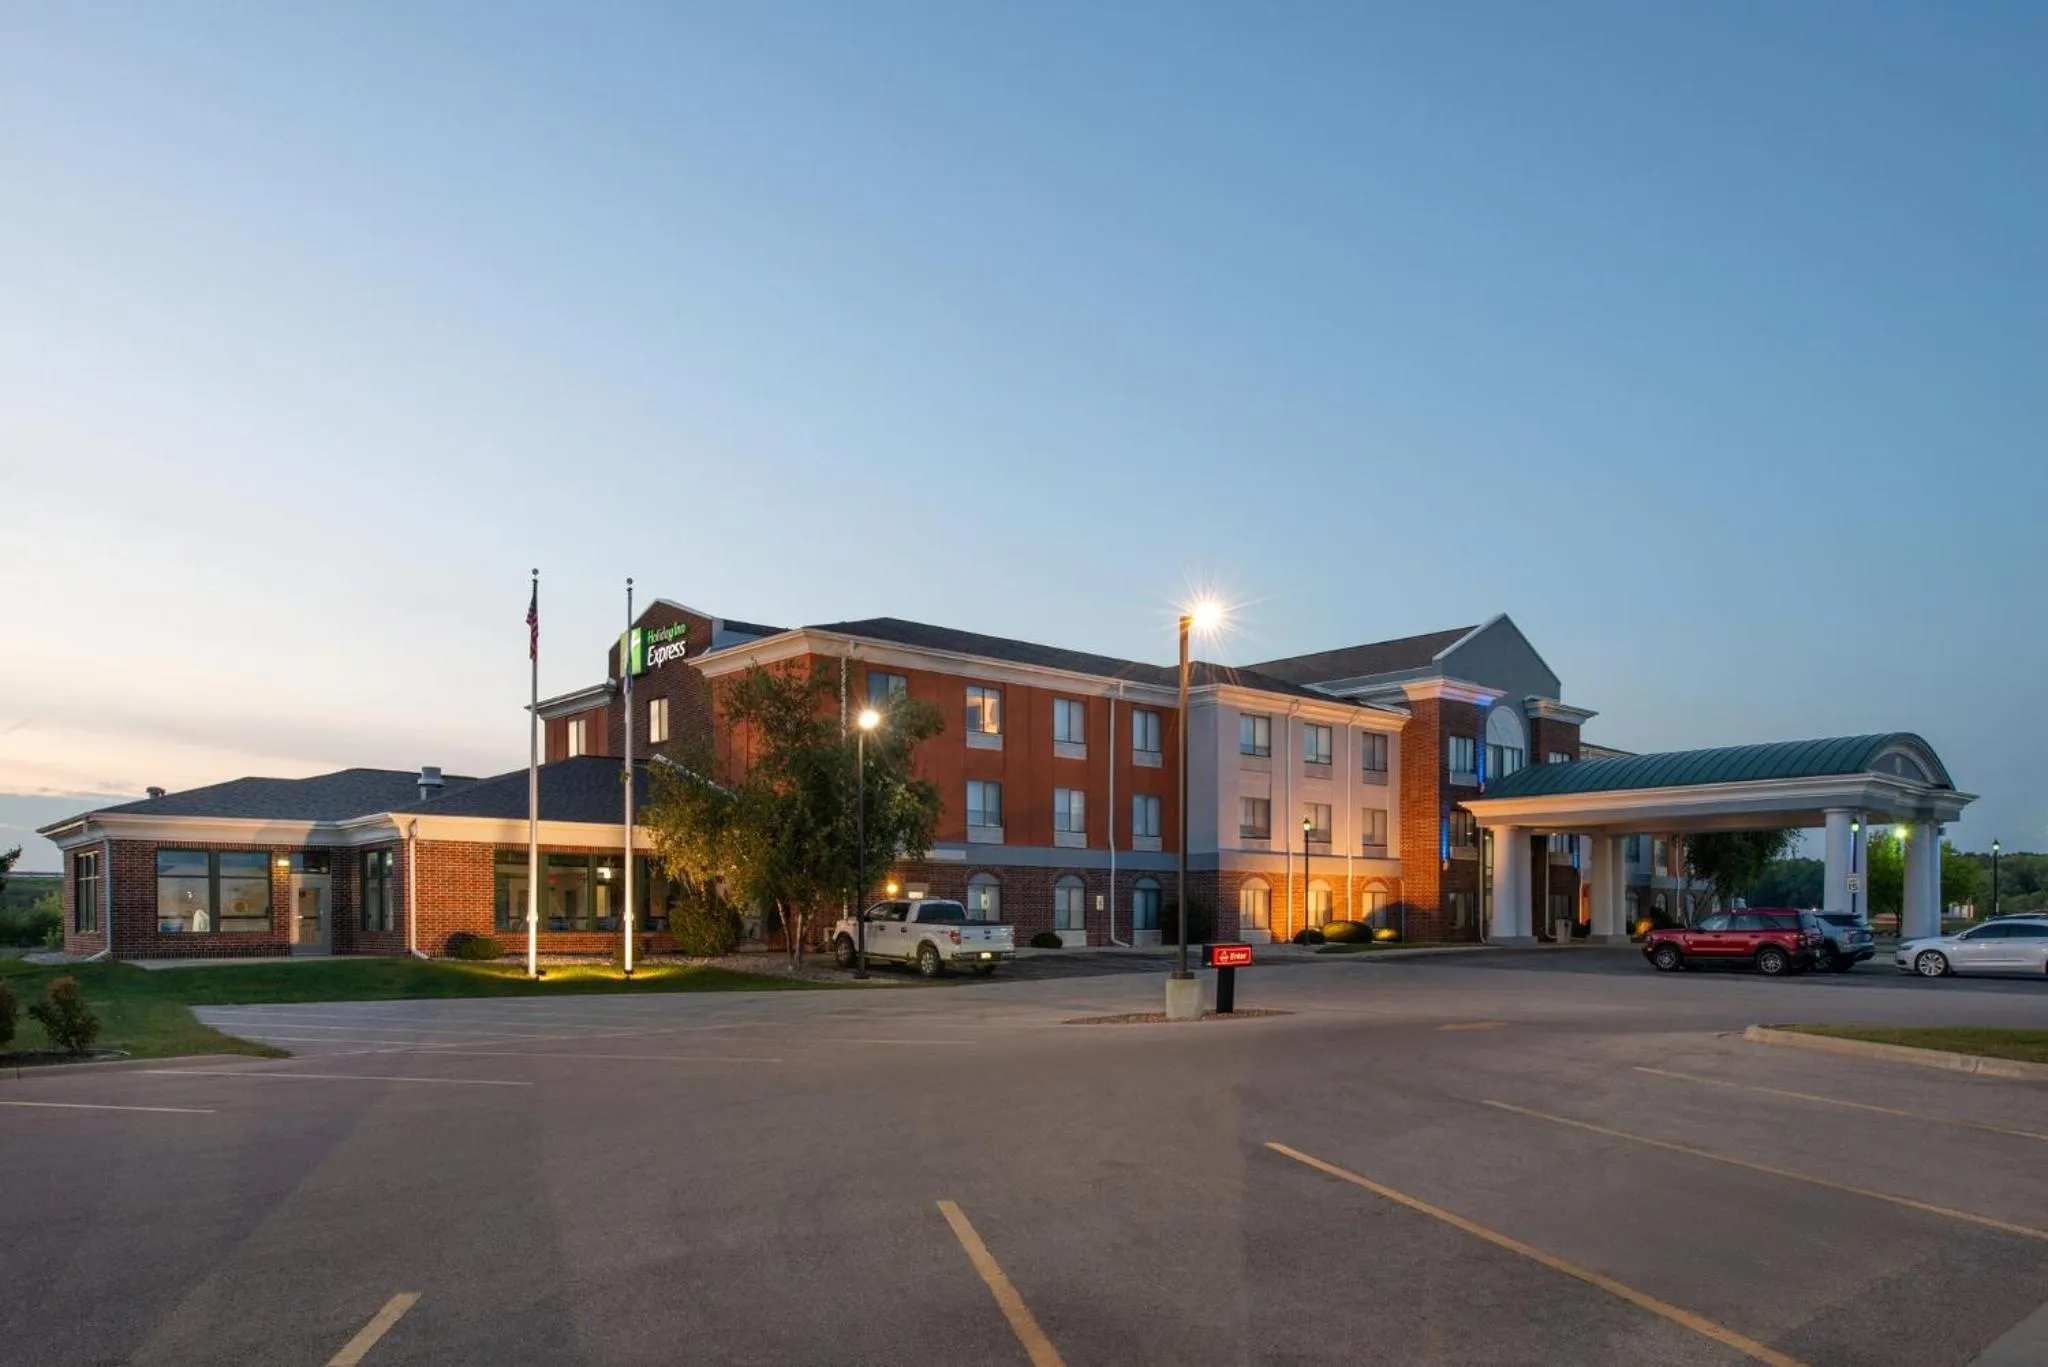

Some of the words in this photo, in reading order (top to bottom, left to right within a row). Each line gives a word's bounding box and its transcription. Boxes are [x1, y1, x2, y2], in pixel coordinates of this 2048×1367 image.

[647, 641, 686, 668] Express
[1848, 883, 1857, 891] 15
[1230, 952, 1246, 960] Enter
